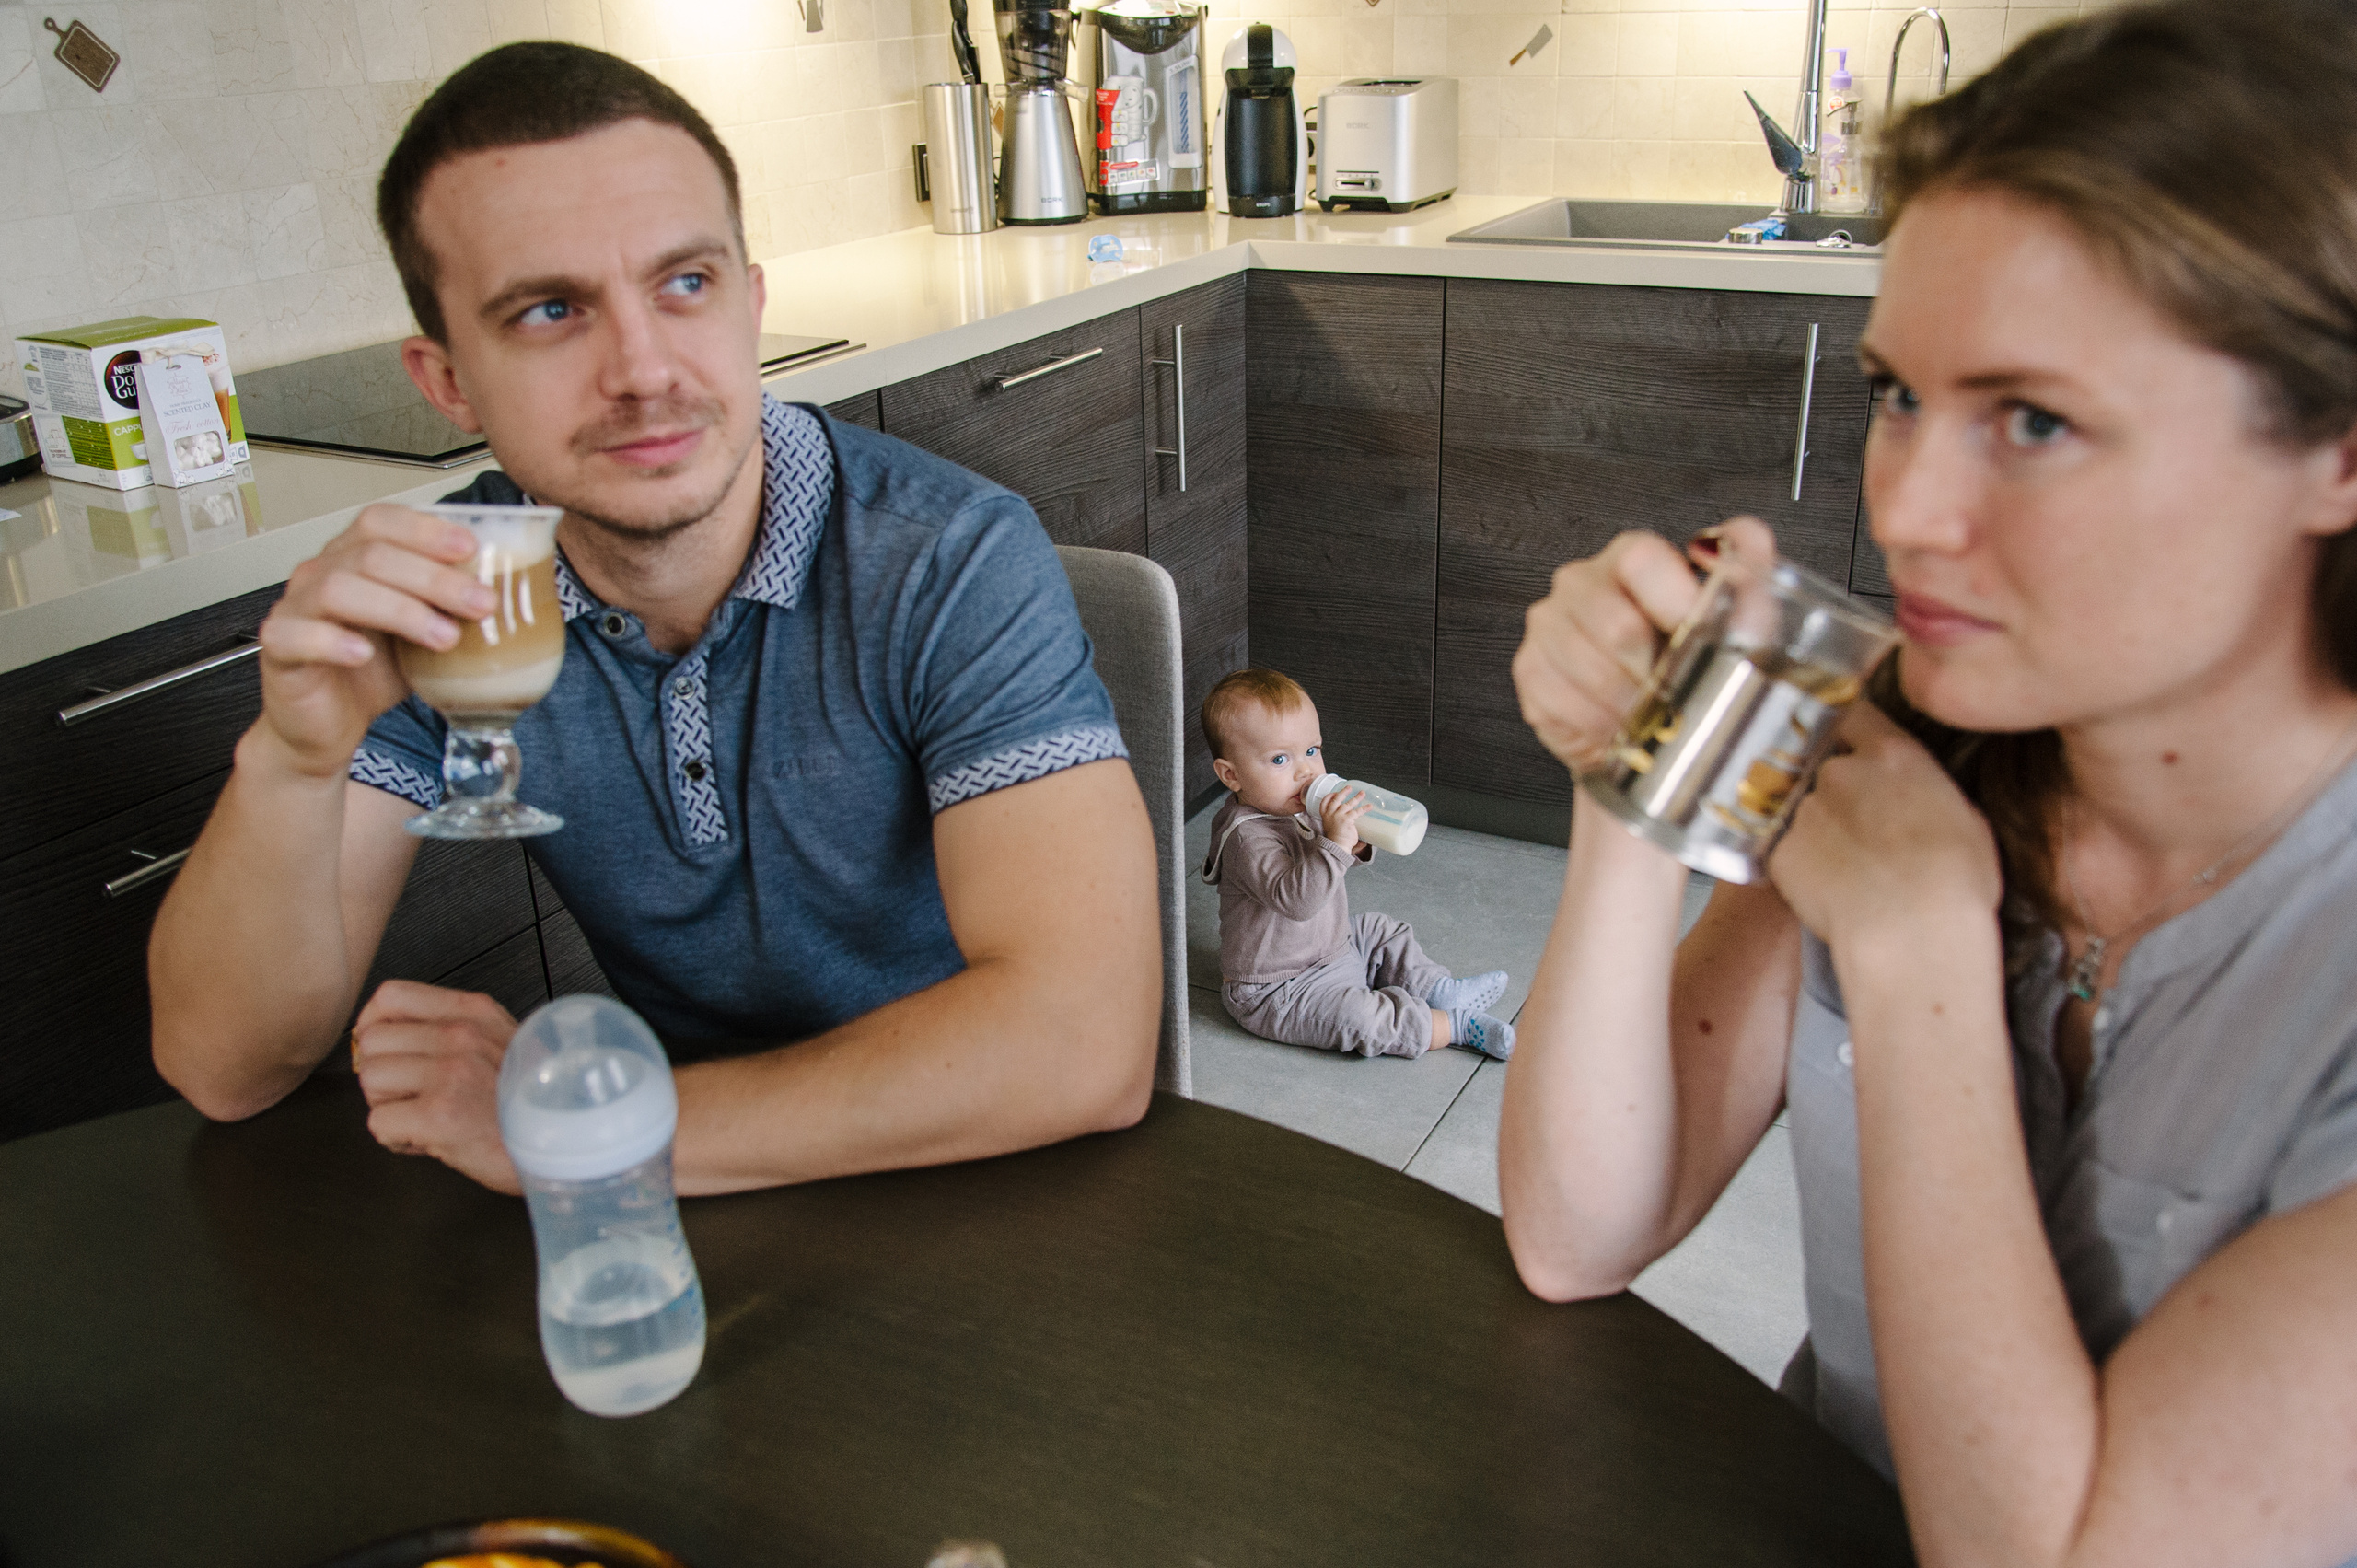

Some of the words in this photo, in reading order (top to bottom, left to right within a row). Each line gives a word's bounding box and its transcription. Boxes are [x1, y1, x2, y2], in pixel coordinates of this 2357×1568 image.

[112, 364, 135, 375] NESC
[163, 406, 194, 417] SCENTED
[193, 401, 211, 411] CLAY
